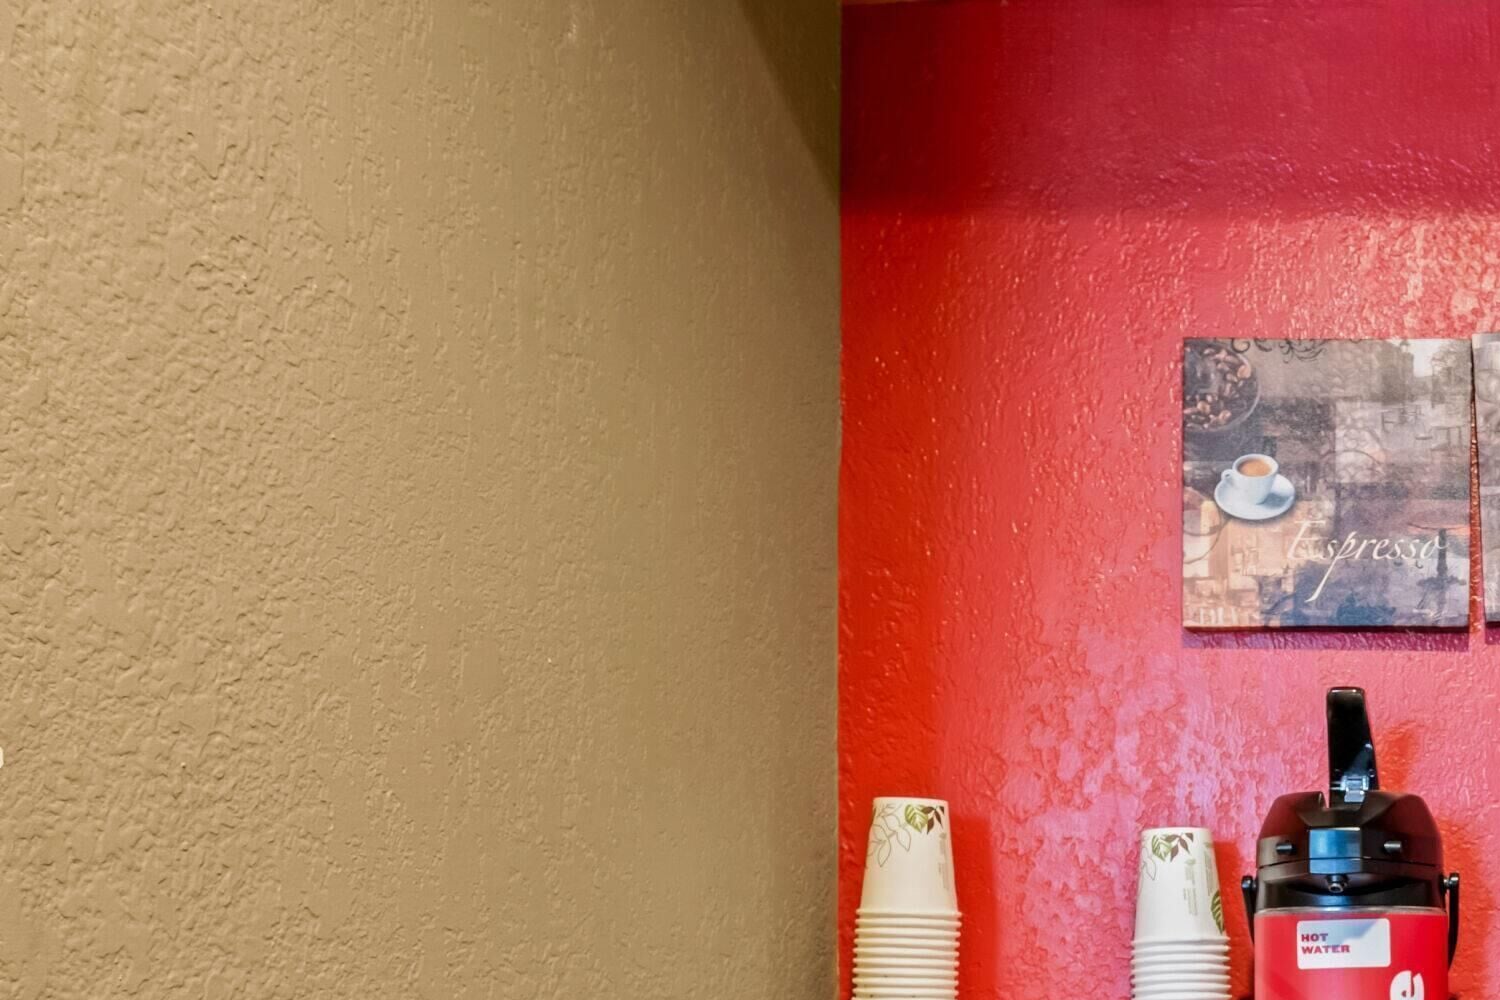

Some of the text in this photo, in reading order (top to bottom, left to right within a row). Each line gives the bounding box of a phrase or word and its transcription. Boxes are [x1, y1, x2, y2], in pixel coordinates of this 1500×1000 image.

[1288, 520, 1448, 603] Espresso
[1301, 933, 1328, 942] HOT
[1301, 945, 1350, 954] WATER
